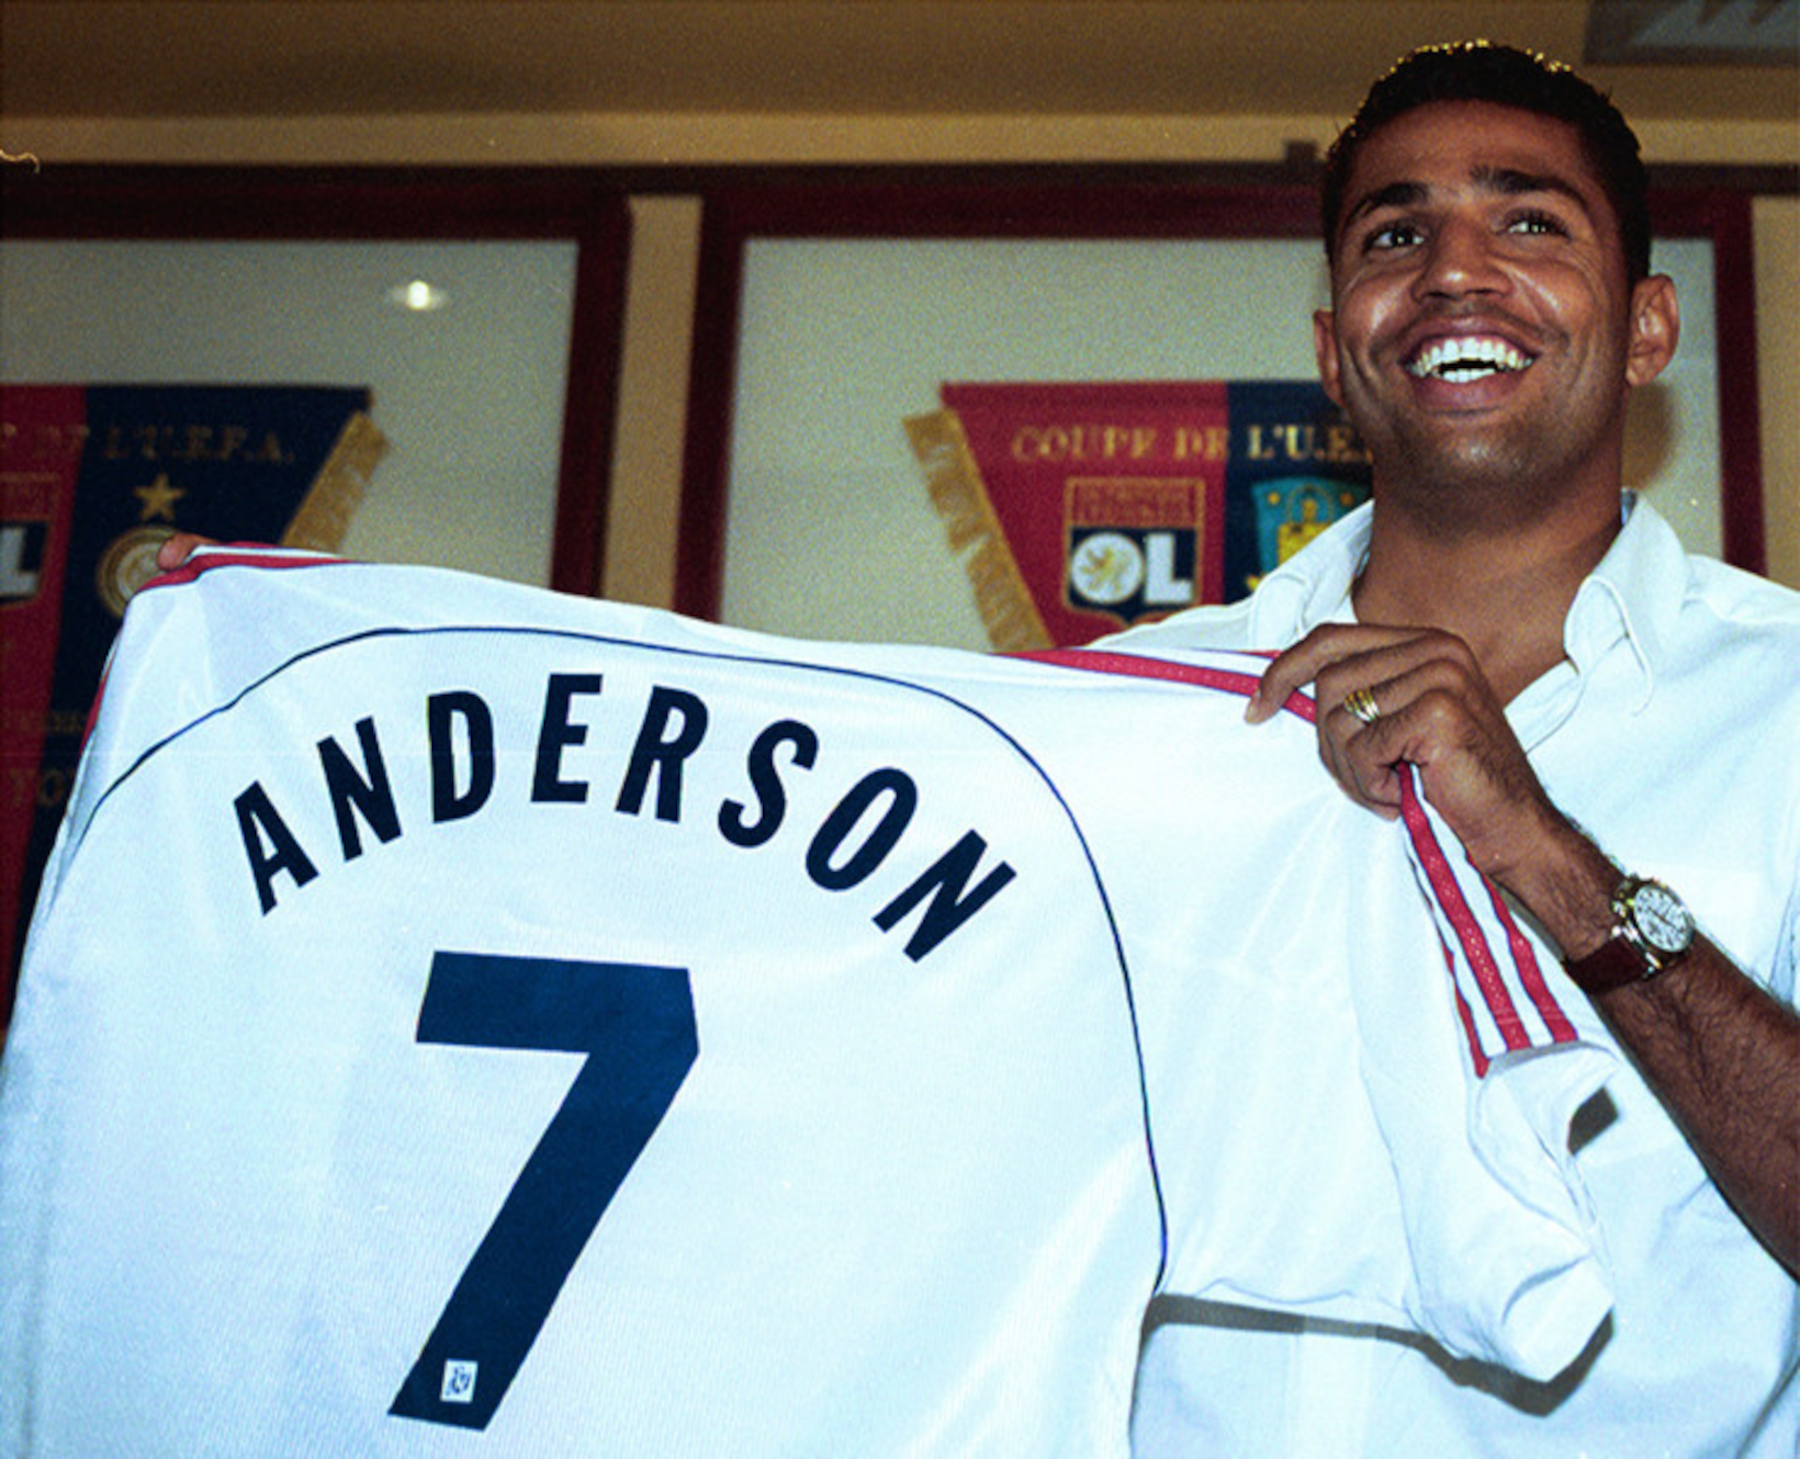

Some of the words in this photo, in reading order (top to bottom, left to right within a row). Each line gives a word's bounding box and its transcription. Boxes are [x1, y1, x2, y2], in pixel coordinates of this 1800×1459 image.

[1010, 423, 1157, 461] COUPE
[1173, 424, 1230, 460] DE
[1070, 532, 1193, 605] OL
[233, 673, 1017, 963] ANDERSON
[387, 950, 700, 1432] 7
